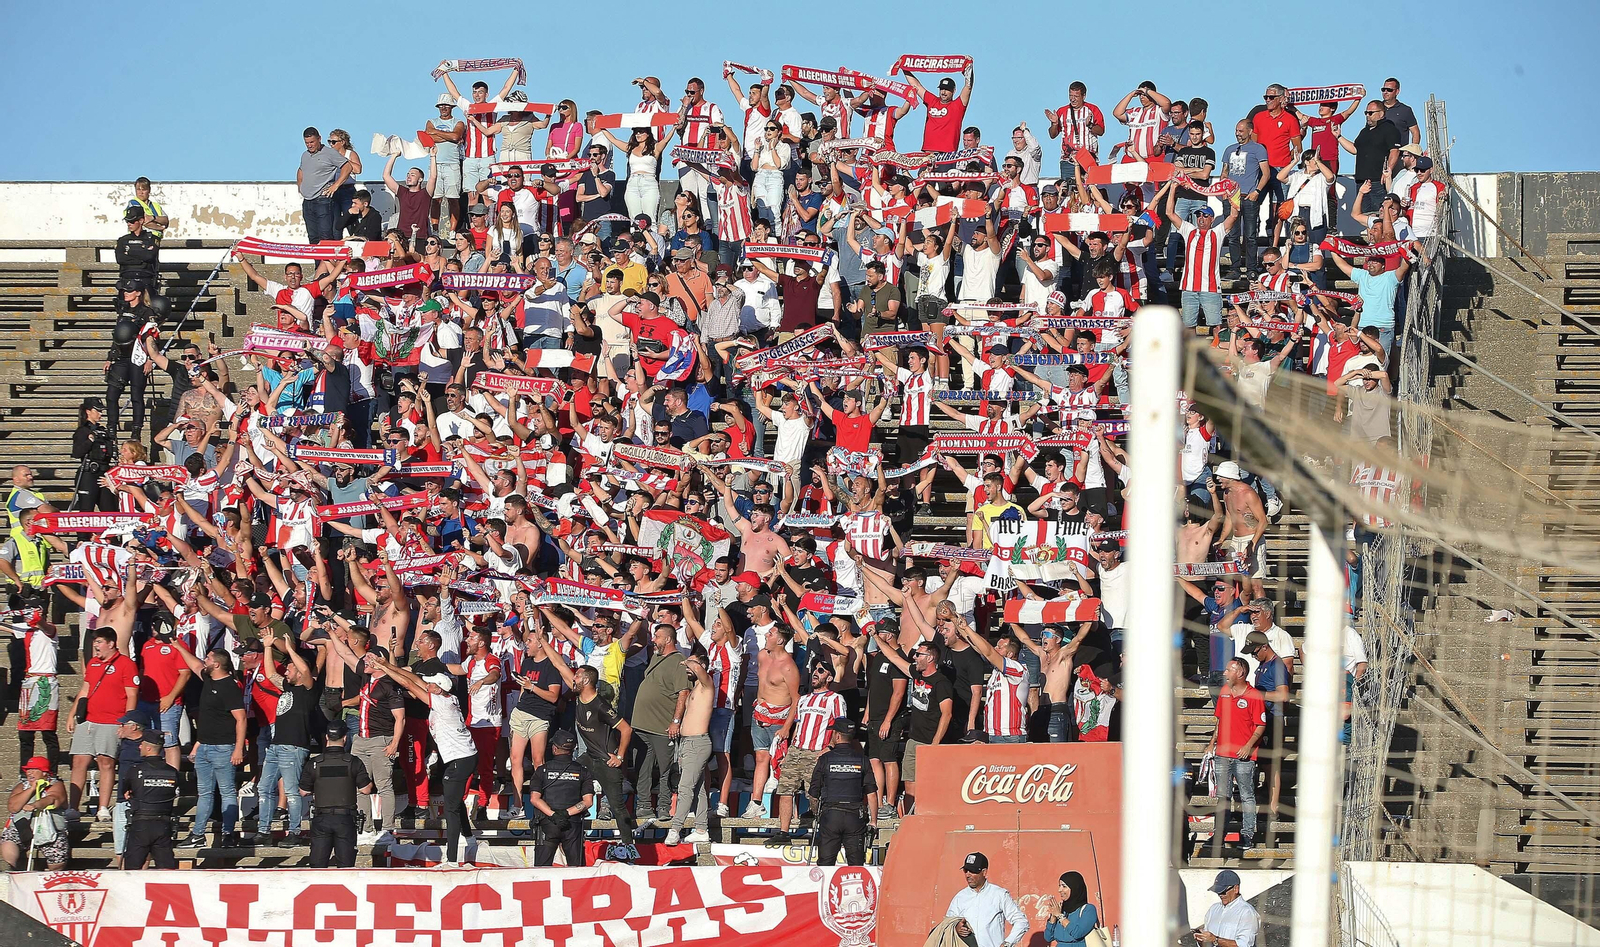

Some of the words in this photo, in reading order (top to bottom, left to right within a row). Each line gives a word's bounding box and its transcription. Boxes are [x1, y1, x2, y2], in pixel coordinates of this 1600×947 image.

[904, 58, 949, 69] ALGECIRAS
[798, 68, 837, 84] ALGECIRAS
[1290, 89, 1334, 103] ALGECIRAS
[1337, 86, 1349, 98] CF
[799, 248, 819, 256] NUEVA
[1338, 240, 1386, 255] ALGECIRAS
[357, 272, 396, 286] ALGECIRAS
[1048, 318, 1101, 328] ALGECIRAS
[758, 337, 806, 363] ALGECIRAS
[1014, 354, 1076, 365] ORIGINAL
[1081, 353, 1109, 364] 1912
[938, 391, 1001, 400] ORIGINAL
[940, 439, 986, 448] KOMANDO
[996, 438, 1025, 448] SHIRA
[58, 517, 113, 528] ALGECIRAS
[1069, 549, 1084, 560] 12
[989, 765, 1017, 773] Disfruta
[961, 763, 1078, 804] Coca-Cola
[140, 866, 788, 947] ALGECIRAS
